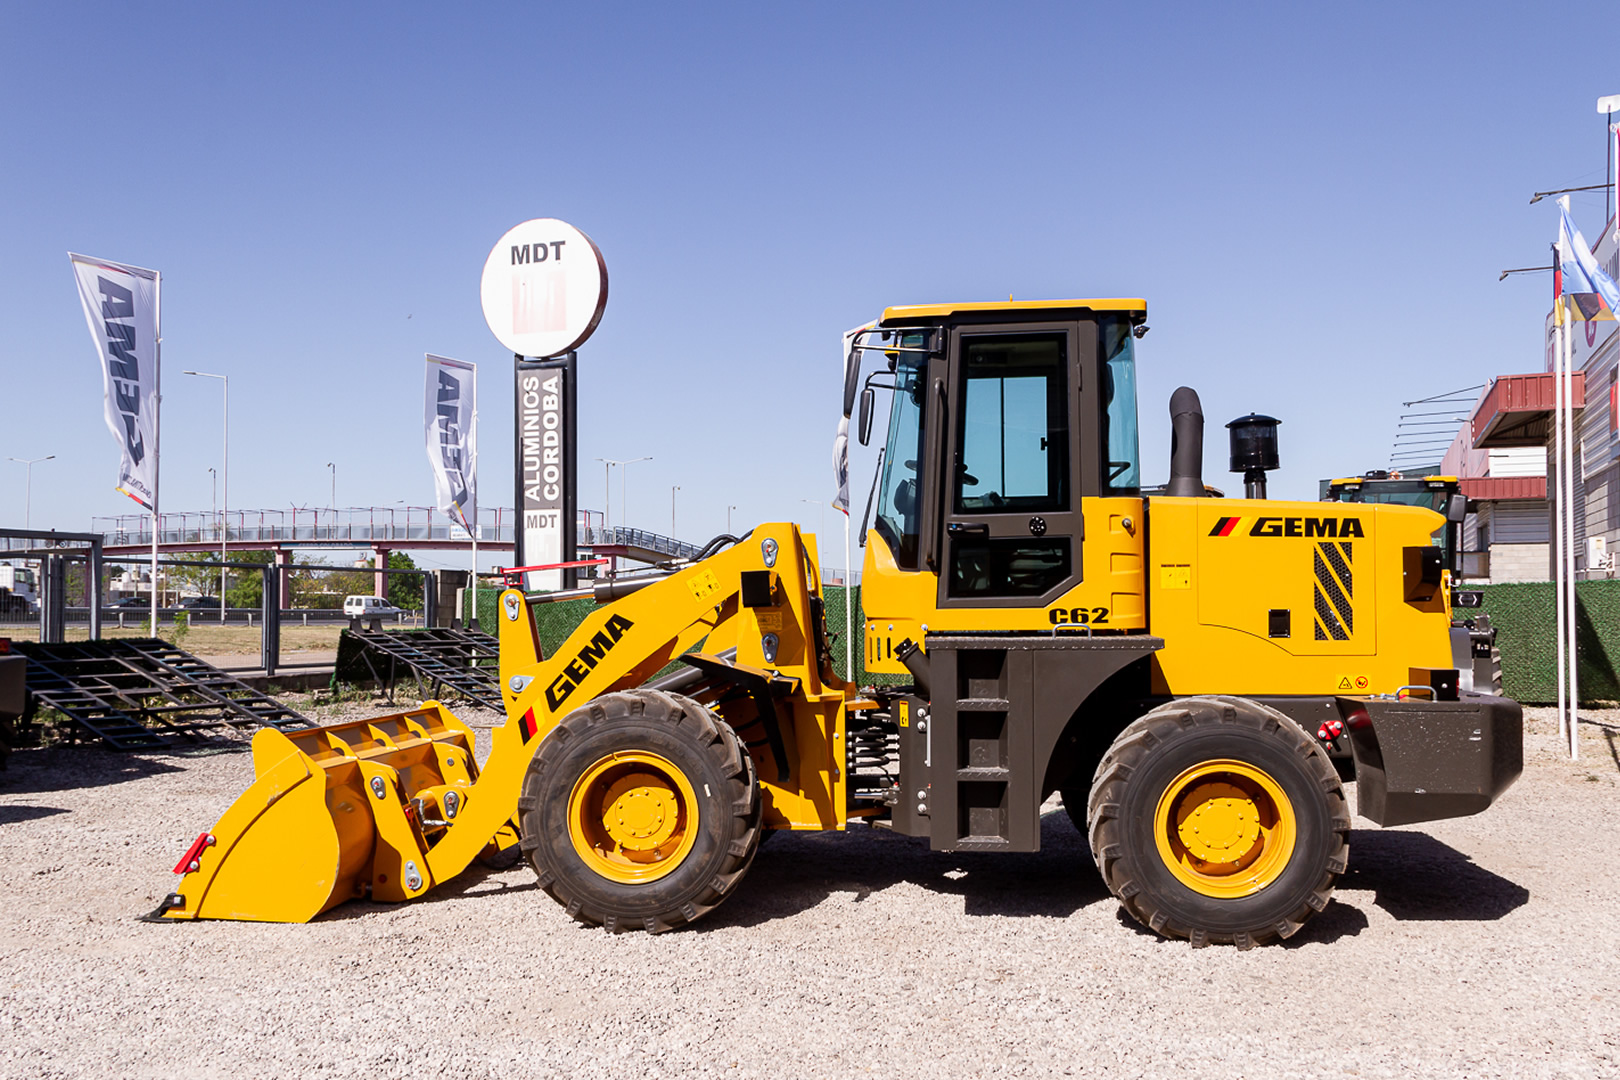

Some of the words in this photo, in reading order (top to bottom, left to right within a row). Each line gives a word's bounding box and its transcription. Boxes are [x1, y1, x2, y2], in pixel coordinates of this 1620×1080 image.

[511, 240, 566, 266] MDT
[523, 376, 540, 502] ALUMINIOS
[542, 376, 560, 501] CORDOBA
[527, 514, 557, 529] MDT
[1249, 517, 1365, 538] GEMA
[1049, 607, 1109, 625] C62
[544, 612, 635, 714] GEMA
